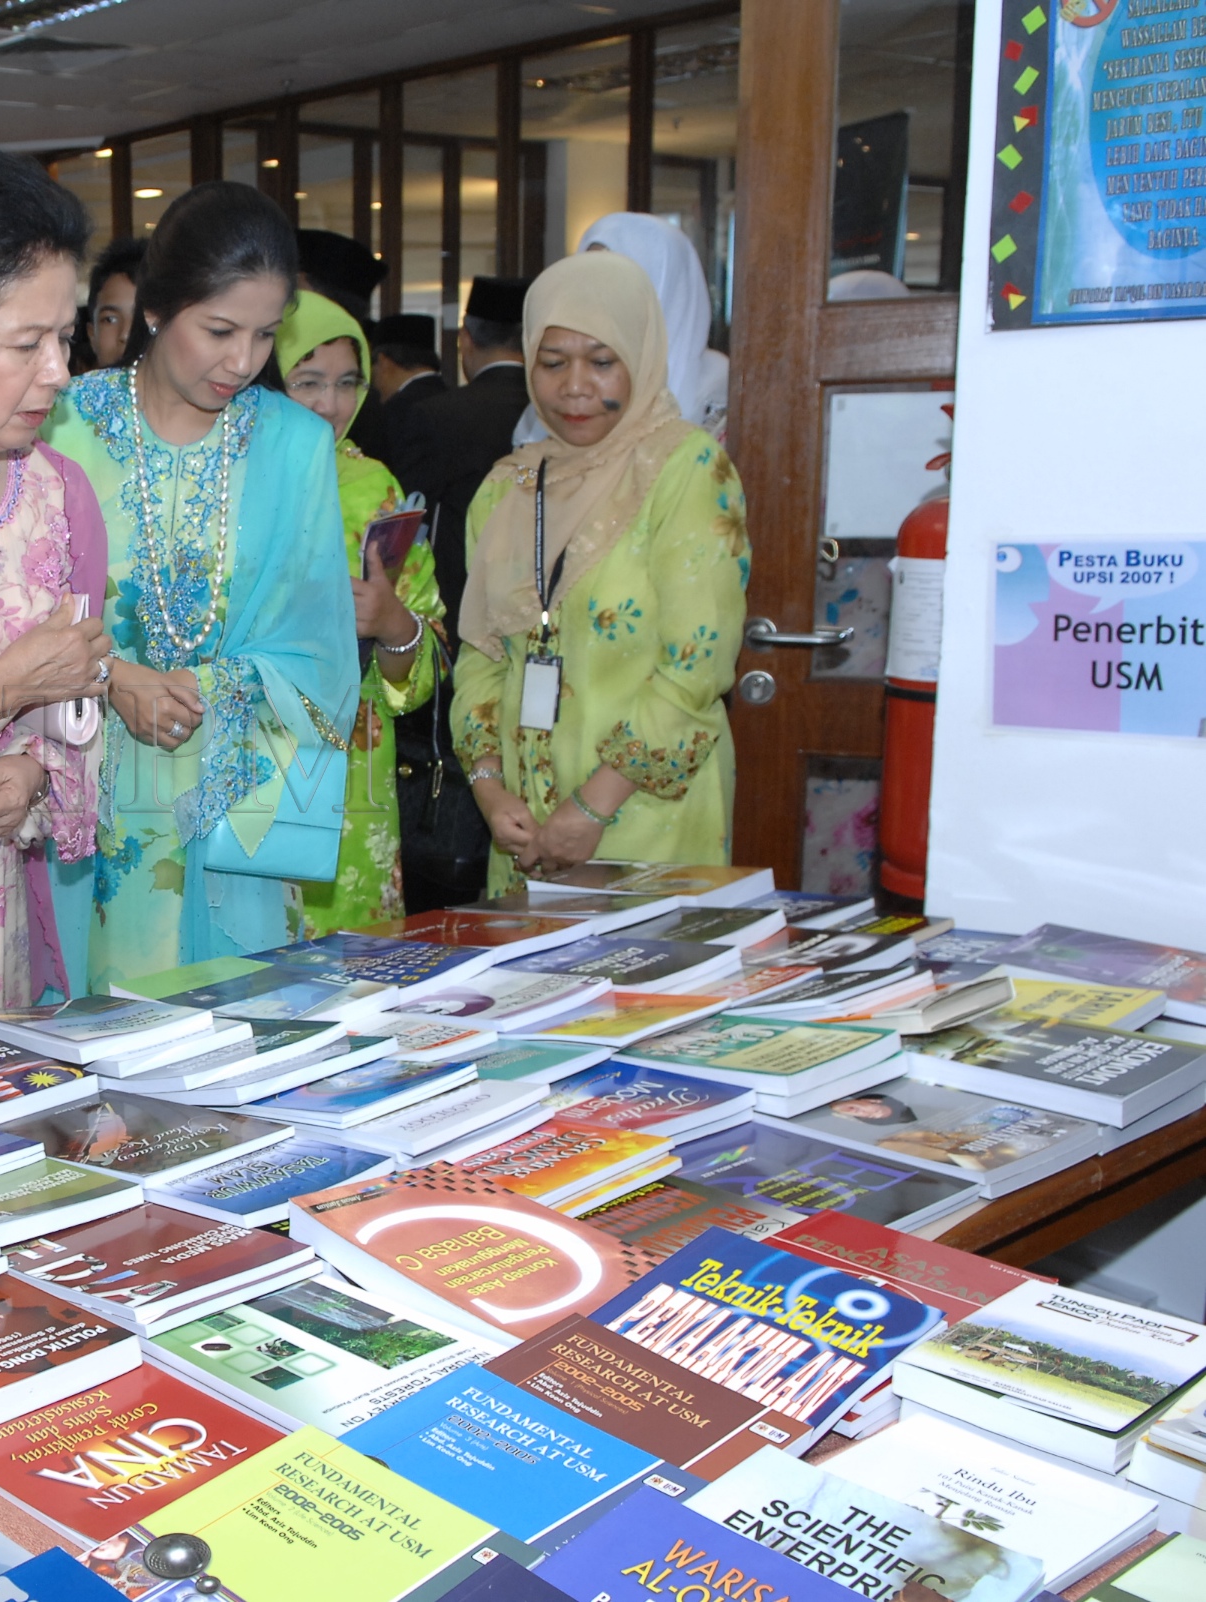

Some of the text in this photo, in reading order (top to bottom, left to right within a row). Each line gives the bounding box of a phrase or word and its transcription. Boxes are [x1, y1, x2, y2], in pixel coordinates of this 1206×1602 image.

[1106, 117, 1142, 141] JARUM
[1182, 108, 1202, 129] ITU
[1106, 141, 1171, 166] LEBIH BAIK
[1123, 197, 1191, 222] YANG TIDAK
[1148, 228, 1198, 249] BAGINYA
[1058, 550, 1183, 567] PESTA BUKU
[1073, 571, 1114, 584] UPSI
[1120, 571, 1163, 584] 2007
[1053, 614, 1204, 647] Penerbit
[1091, 661, 1164, 691] USM
[1074, 1041, 1173, 1086] EKONOMI
[462, 1131, 556, 1168] from Gas
[474, 1130, 600, 1178] DIAMOND
[503, 1137, 607, 1179] Growing
[203, 1155, 330, 1200] TASAWWUR
[204, 1160, 279, 1185] ISLAM
[158, 1229, 218, 1254] CHANGING
[160, 1228, 252, 1264] MASS MEDIA
[184, 1226, 242, 1249] DIVERSITY
[394, 1225, 506, 1271] Bahasa C
[122, 1252, 160, 1266] TIMES
[433, 1237, 530, 1278] Menggunakan
[443, 1244, 551, 1290] Pengaturcaraan
[793, 1233, 995, 1304] PENGURUSAN
[864, 1247, 950, 1277] ASAS
[466, 1257, 559, 1297] Konsep Asas
[680, 1258, 885, 1359] Teknik-Teknik
[1040, 1300, 1100, 1320] JEMOQ
[1051, 1293, 1165, 1328] TUNGGU PADI
[0, 1334, 54, 1357] Pendidikan
[43, 1324, 108, 1353] POLITIK
[45, 1325, 56, 1333] di
[54, 1322, 86, 1337] dalam
[538, 1372, 564, 1389] Editors
[551, 1343, 711, 1429] RESEARCH AT USM
[566, 1334, 695, 1405] FUNDAMENTAL
[368, 1375, 432, 1405] FORESTS
[530, 1382, 582, 1414] Lim Koon Ong
[537, 1377, 603, 1418] Abd. Aziz Tajuddin
[9, 1402, 158, 1465] Corak Pemikiran,
[25, 1404, 113, 1444] Sains dan
[431, 1427, 456, 1444] Editors
[445, 1396, 608, 1484] RESEARCH AT USM
[461, 1386, 593, 1459] FUNDAMENTAL
[35, 1417, 208, 1490] CINA
[422, 1436, 474, 1467] Lim Koon Ong
[445, 1440, 463, 1455] Aziz
[462, 1447, 496, 1471] Tajuddin
[86, 1439, 248, 1510] TAMADUN
[293, 1451, 423, 1531] FUNDAMENTAL
[954, 1467, 1007, 1494] Rindu
[1008, 1489, 1038, 1507] Ibu
[256, 1497, 281, 1516] Editors
[274, 1462, 434, 1559] RESEARCH AT USM
[245, 1508, 295, 1545] Lim Koon Ong
[253, 1504, 318, 1549] Abd. Aziz Tajuddin
[840, 1505, 912, 1549] THE
[761, 1499, 947, 1594] SCIENTIFIC
